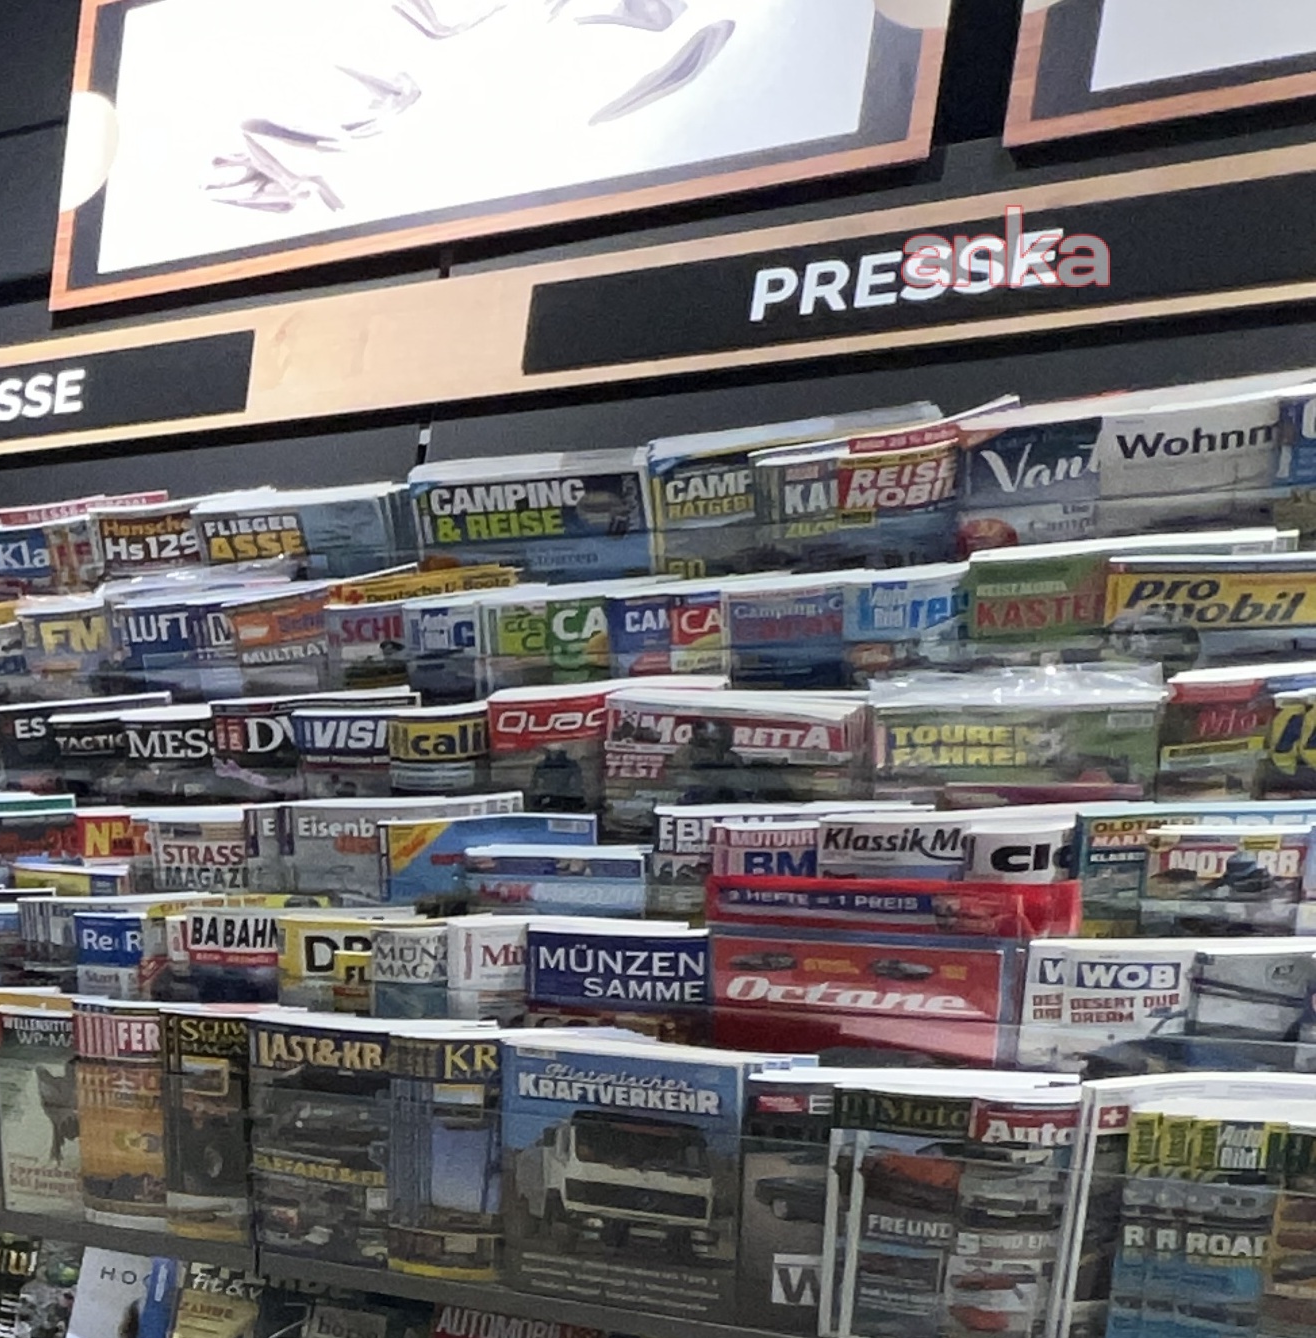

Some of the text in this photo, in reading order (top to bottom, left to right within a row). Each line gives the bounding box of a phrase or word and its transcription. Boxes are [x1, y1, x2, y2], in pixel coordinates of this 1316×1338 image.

[749, 229, 1063, 322] PRESSE
[845, 458, 958, 510] REISE MOBIL
[430, 479, 586, 543] CAMPING & REISE
[204, 515, 301, 561] FLIEGER ASSE
[1131, 578, 1305, 625] pro mobil
[538, 942, 707, 1003] MÜNZEN SAMME
[724, 974, 987, 1016] Octane
[444, 1043, 498, 1079] KR
[517, 1071, 720, 1116] KRAFTVERKEHR
